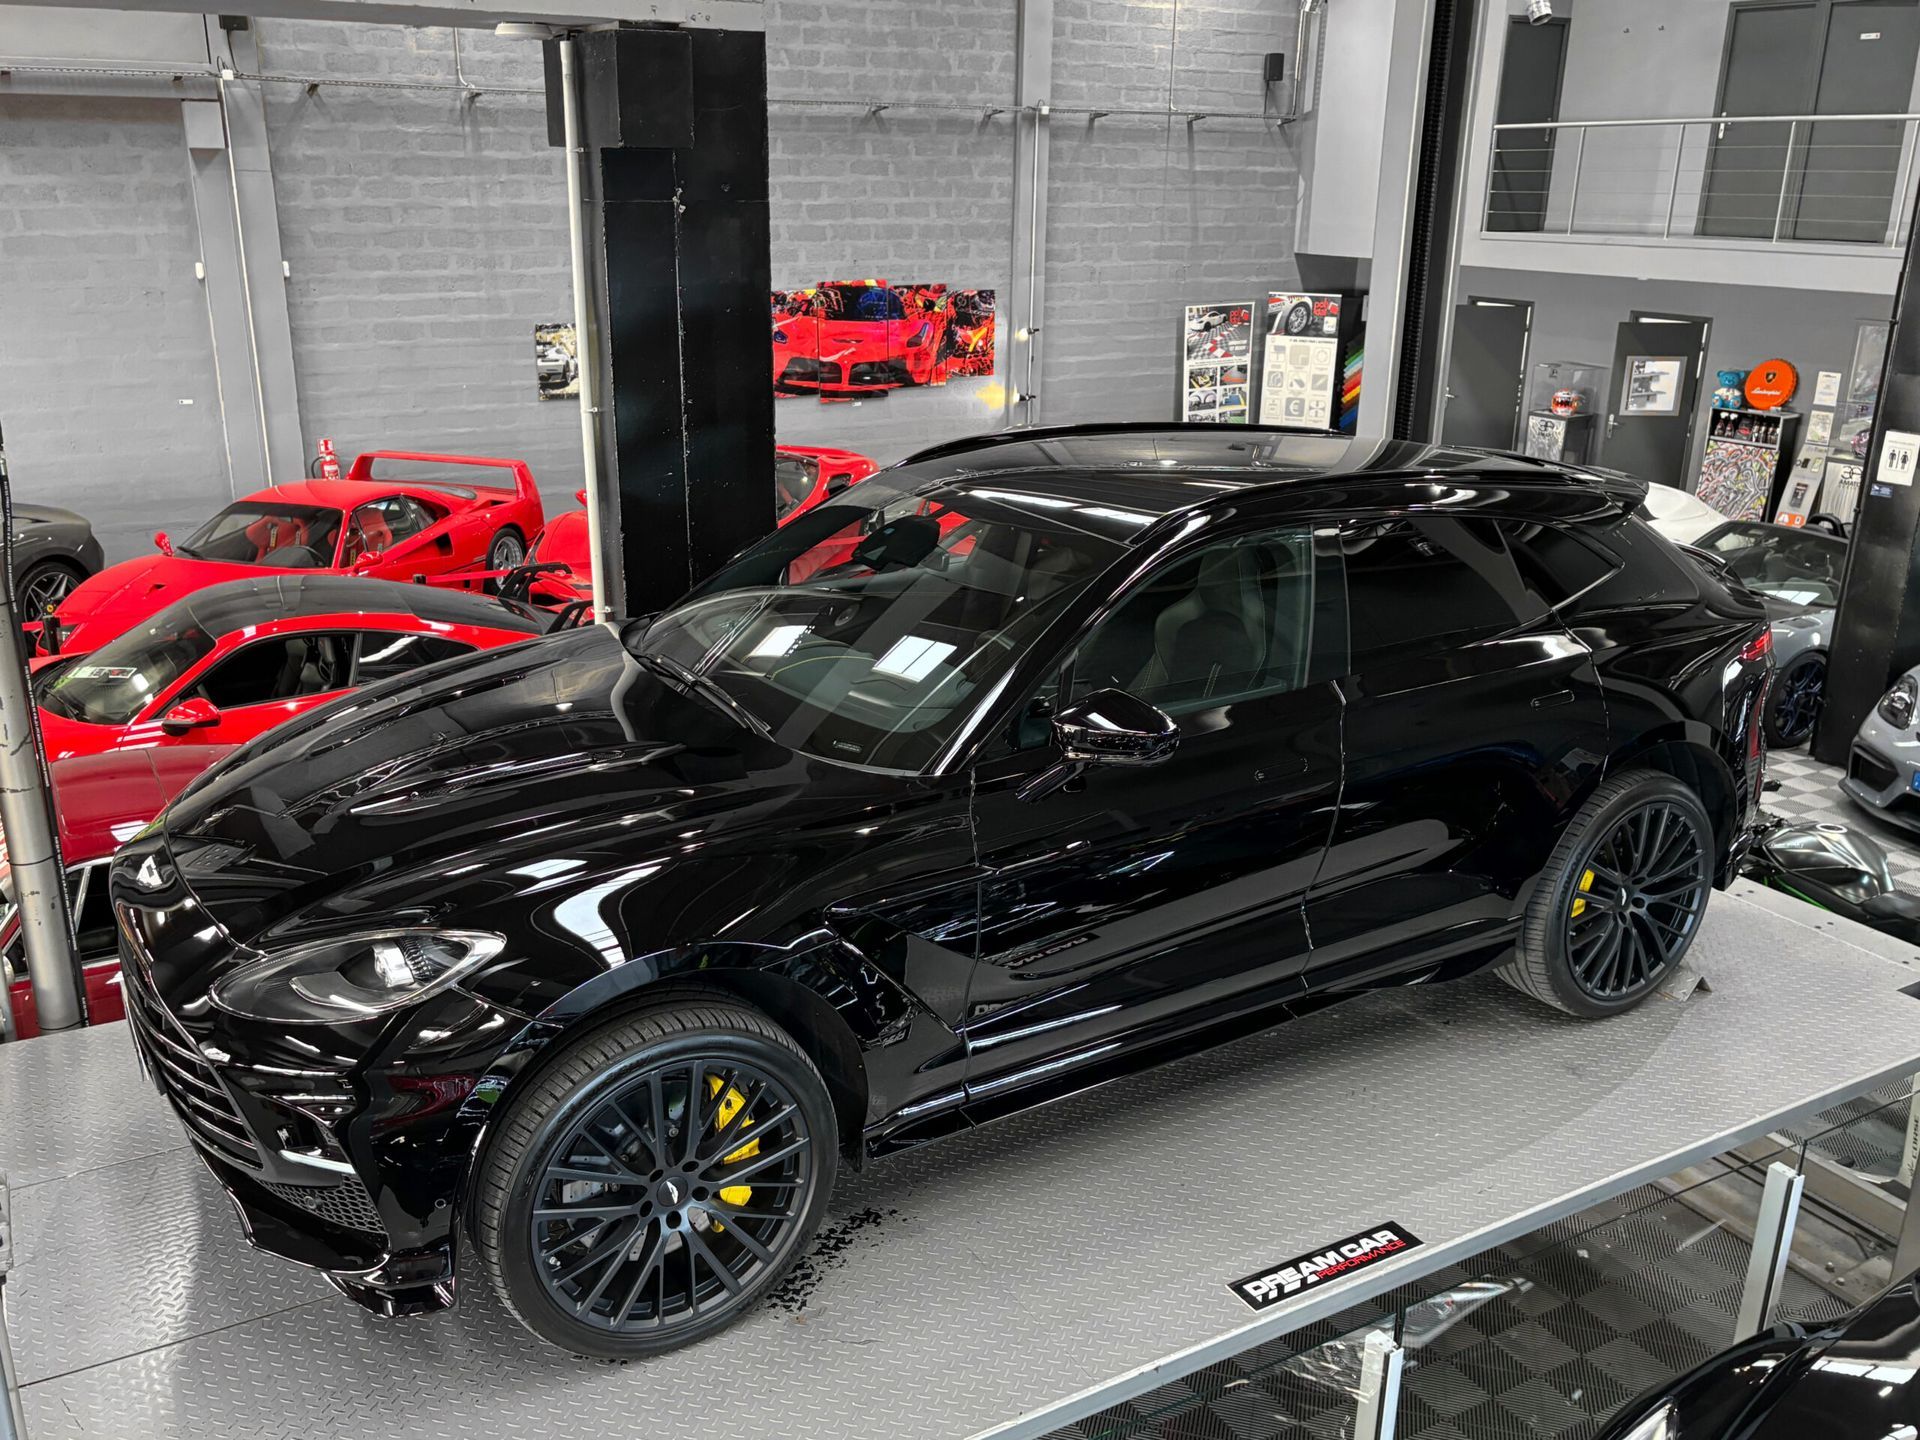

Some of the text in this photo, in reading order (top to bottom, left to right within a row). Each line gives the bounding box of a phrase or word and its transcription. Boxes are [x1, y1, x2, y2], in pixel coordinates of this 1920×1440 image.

[1242, 1229, 1399, 1297] DREAM CAR
[1317, 1239, 1407, 1279] PERFORMANCE
